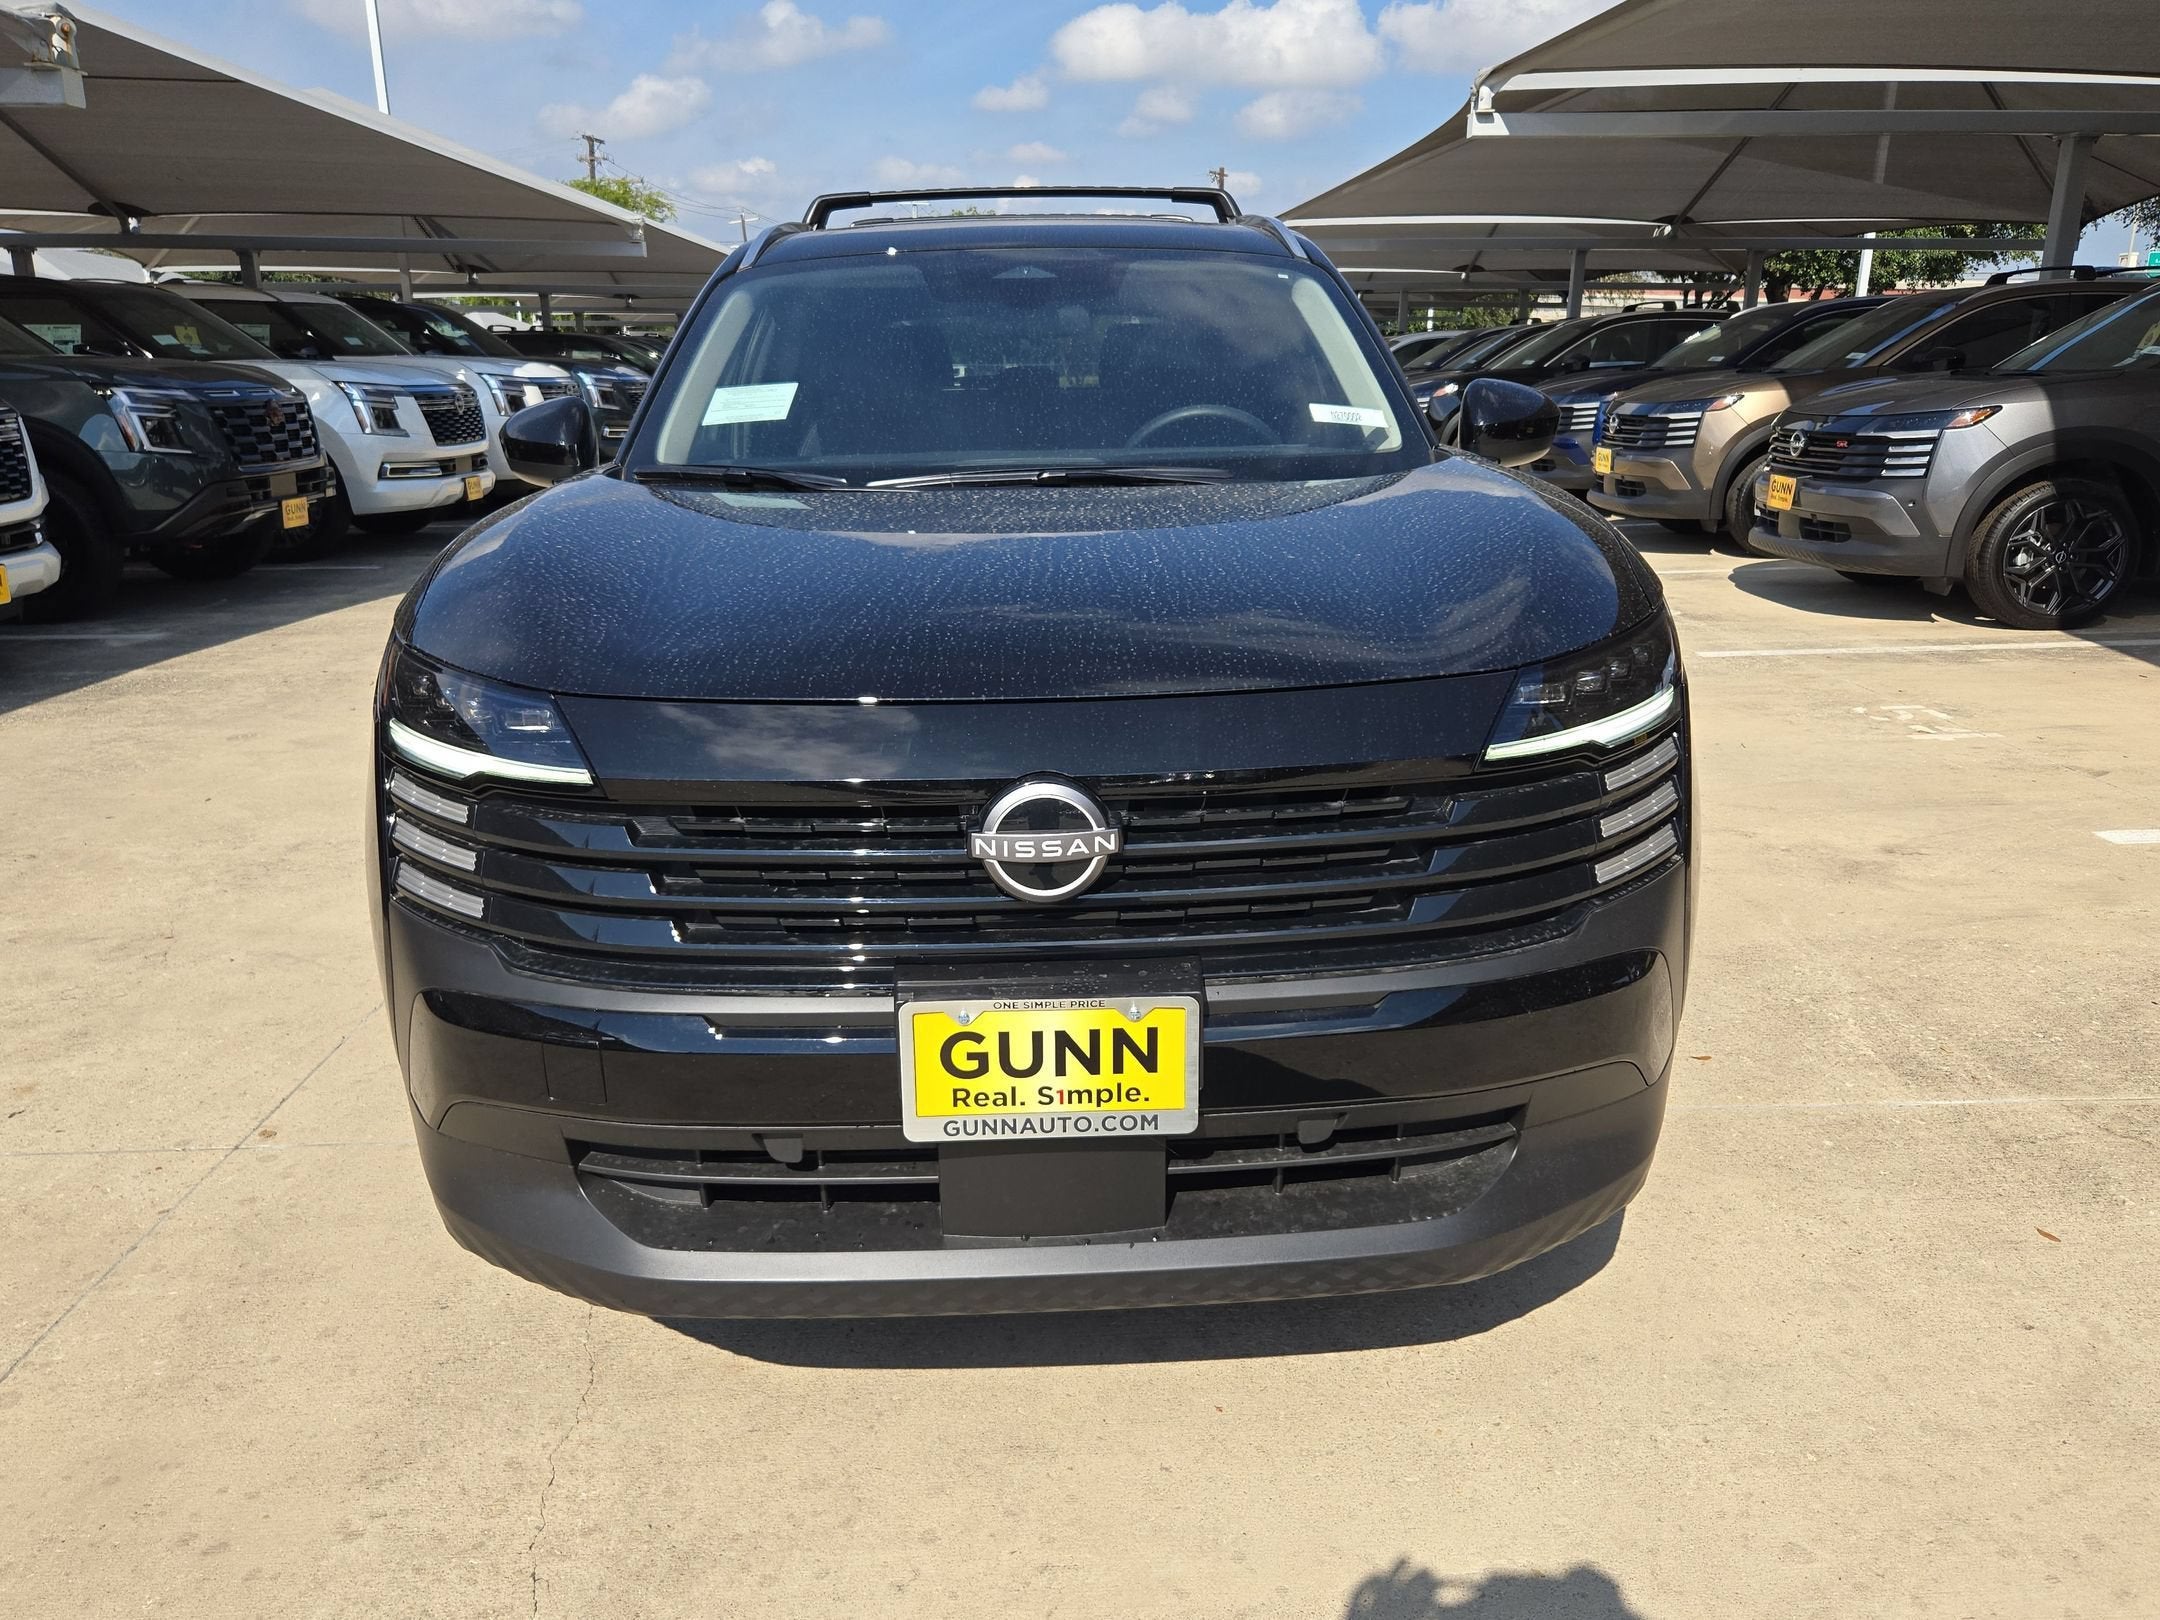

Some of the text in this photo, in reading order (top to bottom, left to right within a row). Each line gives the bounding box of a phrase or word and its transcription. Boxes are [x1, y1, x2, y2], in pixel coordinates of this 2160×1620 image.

[1771, 479, 1793, 495] GUNN
[285, 502, 307, 515] GUNN
[974, 833, 1116, 858] NISSAN
[993, 1000, 1106, 1010] ONE SIMPLE PRICE
[939, 1027, 1158, 1079] GUNN
[952, 1086, 1026, 1107] Real.
[943, 1114, 1159, 1137] GUNNAUTO.COM
